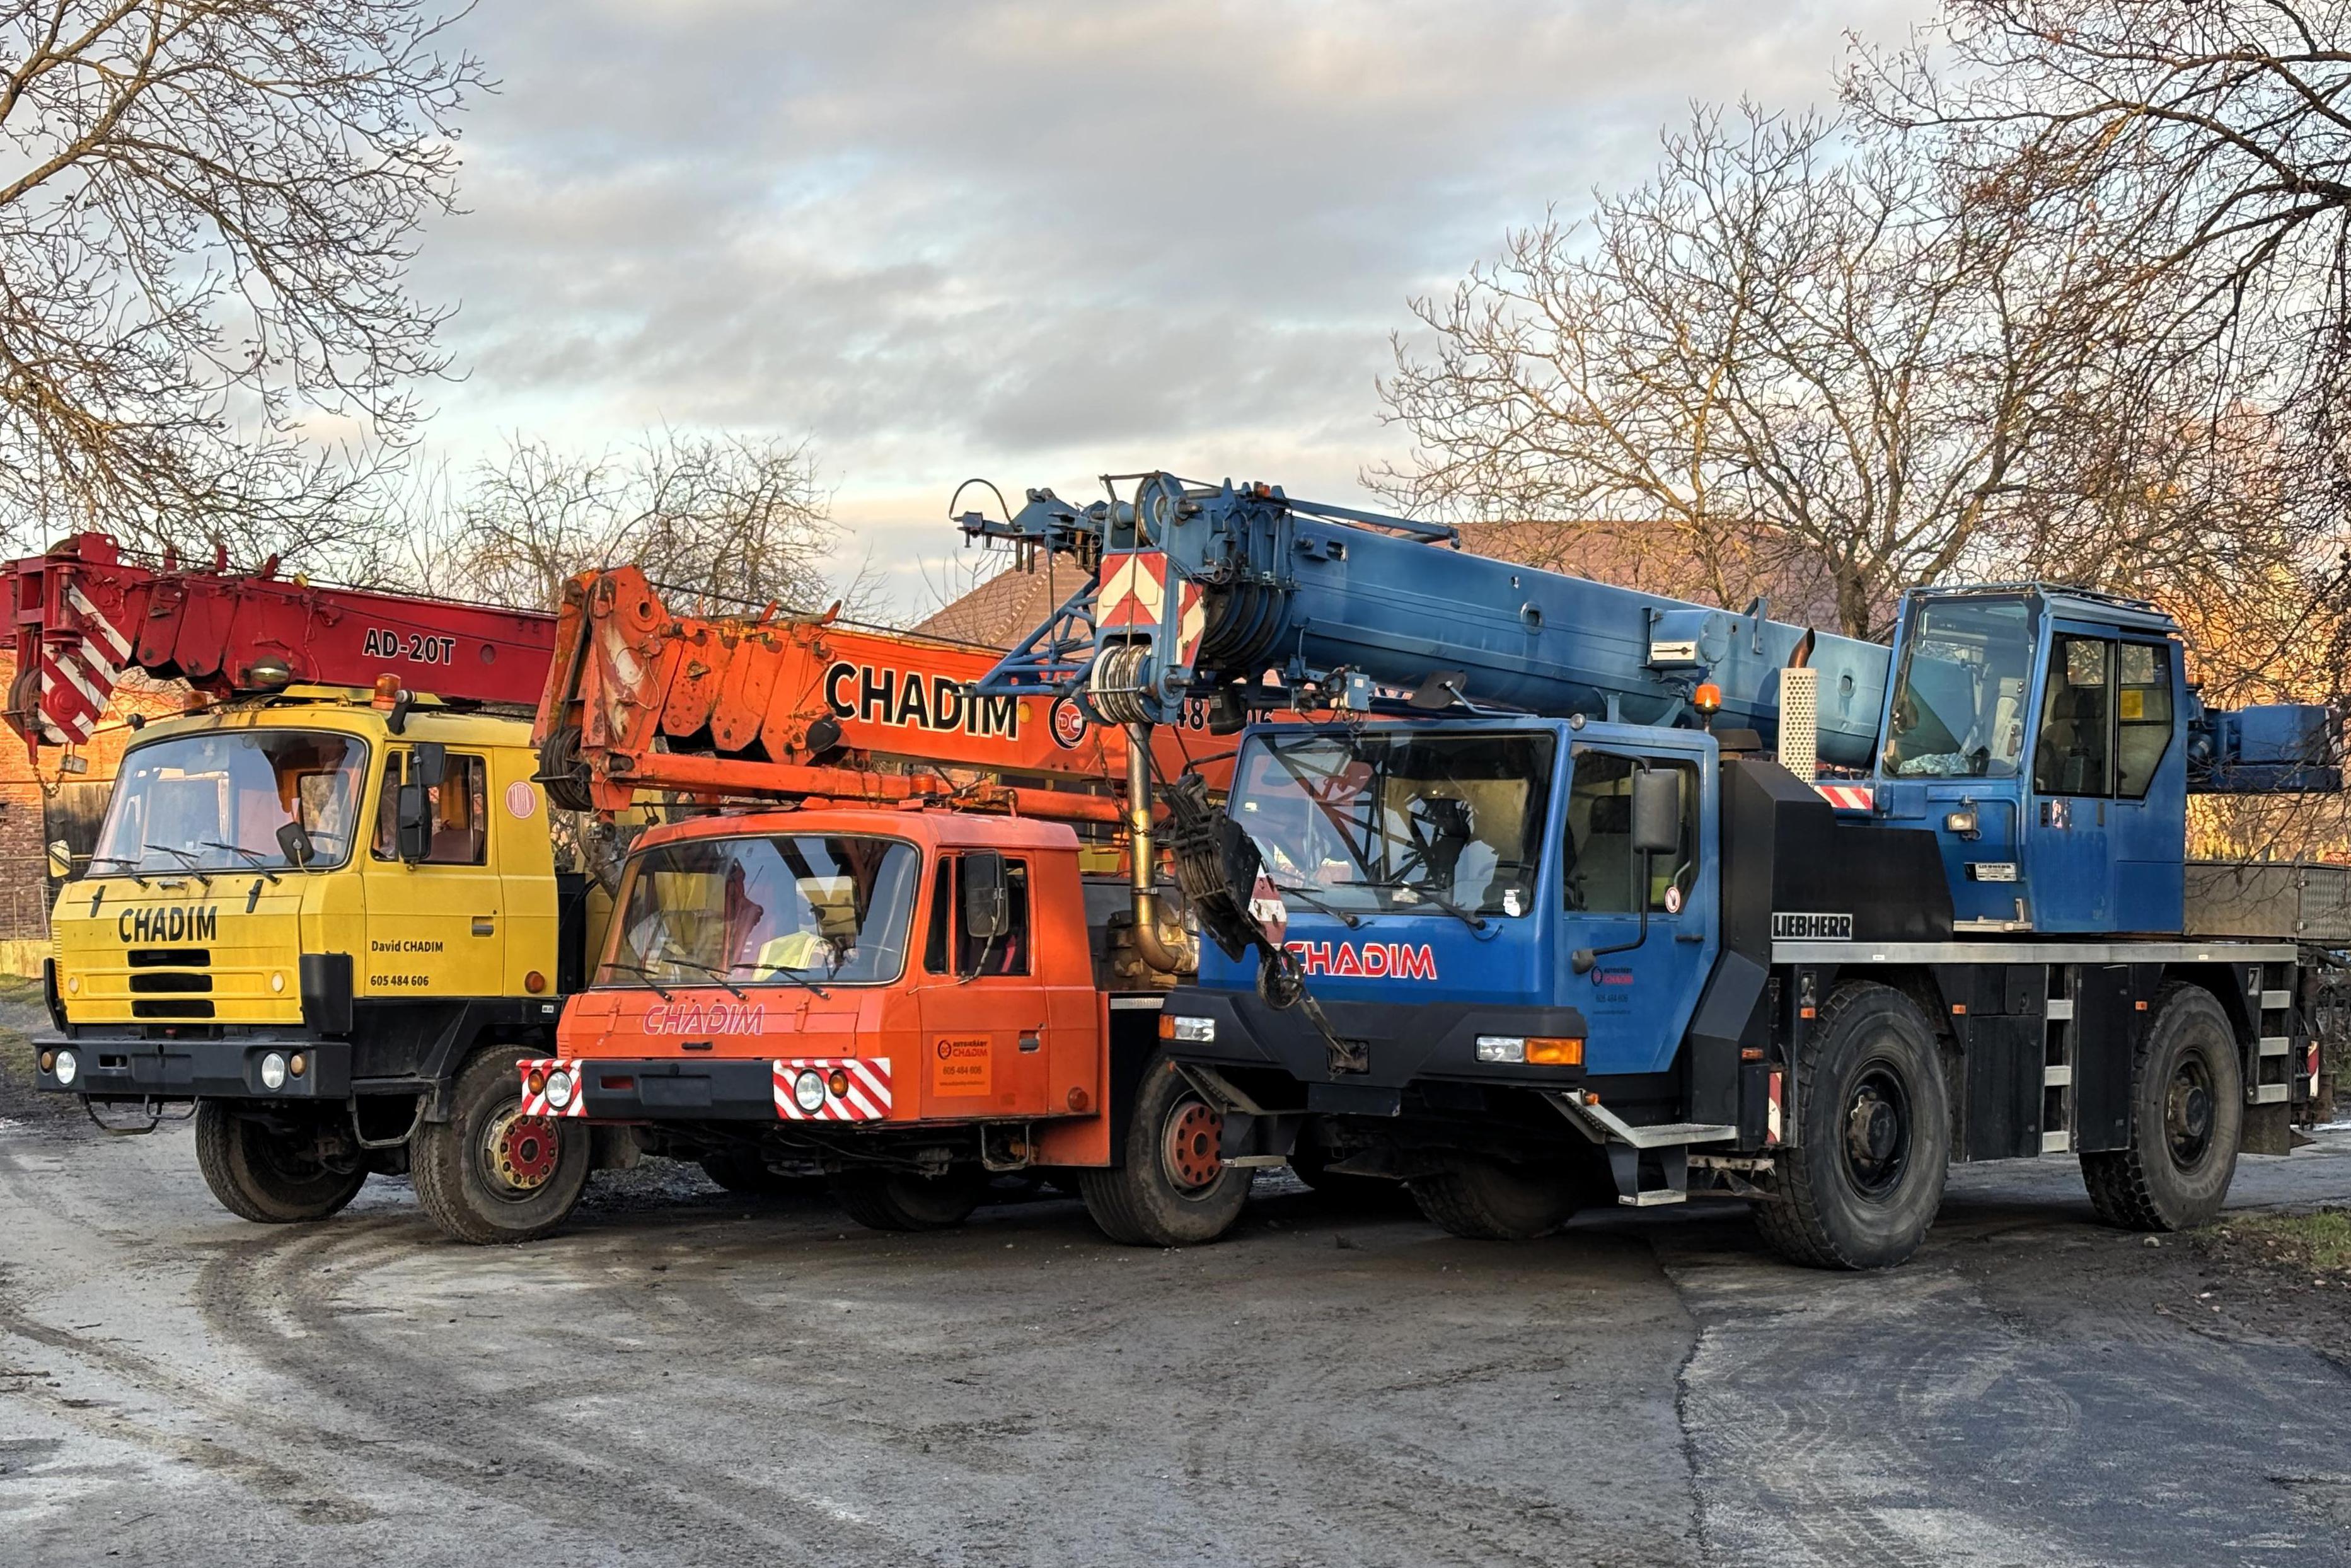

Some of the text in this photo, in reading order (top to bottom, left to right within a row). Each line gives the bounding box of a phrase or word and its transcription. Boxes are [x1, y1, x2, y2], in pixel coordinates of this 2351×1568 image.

[362, 628, 456, 666] AD-20T
[823, 660, 1019, 741] CHADIM
[118, 906, 217, 943] CHADIM
[1772, 914, 1851, 938] LIEBHERR
[371, 939, 443, 952] David CHADIM
[370, 975, 429, 986] 605 484 606
[643, 1004, 765, 1035] CHADIM
[952, 1048, 988, 1057] CHADIM
